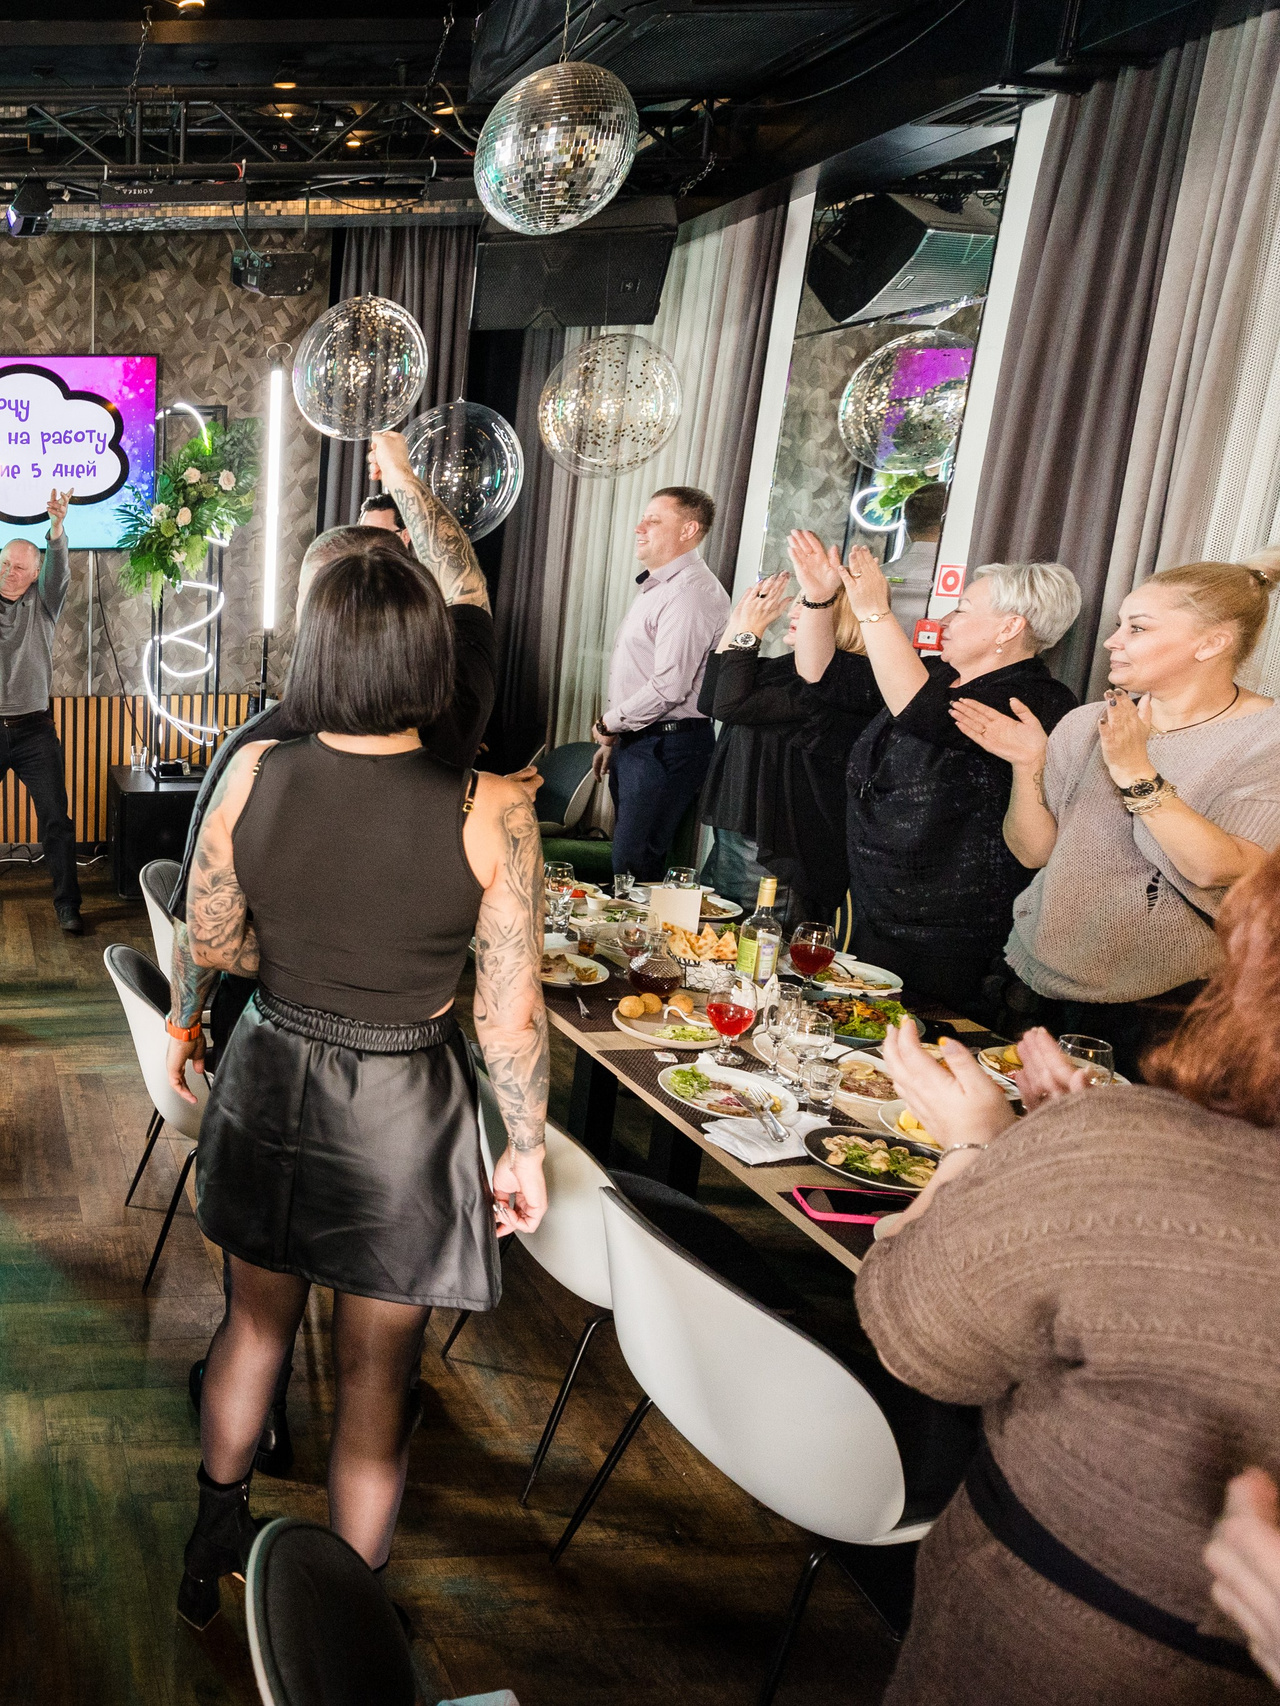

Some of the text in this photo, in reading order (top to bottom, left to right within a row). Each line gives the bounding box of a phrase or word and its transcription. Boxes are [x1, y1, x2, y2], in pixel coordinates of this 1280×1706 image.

[7, 431, 31, 445] на
[40, 429, 108, 456] работу
[31, 463, 42, 479] 5
[52, 460, 97, 478] дней
